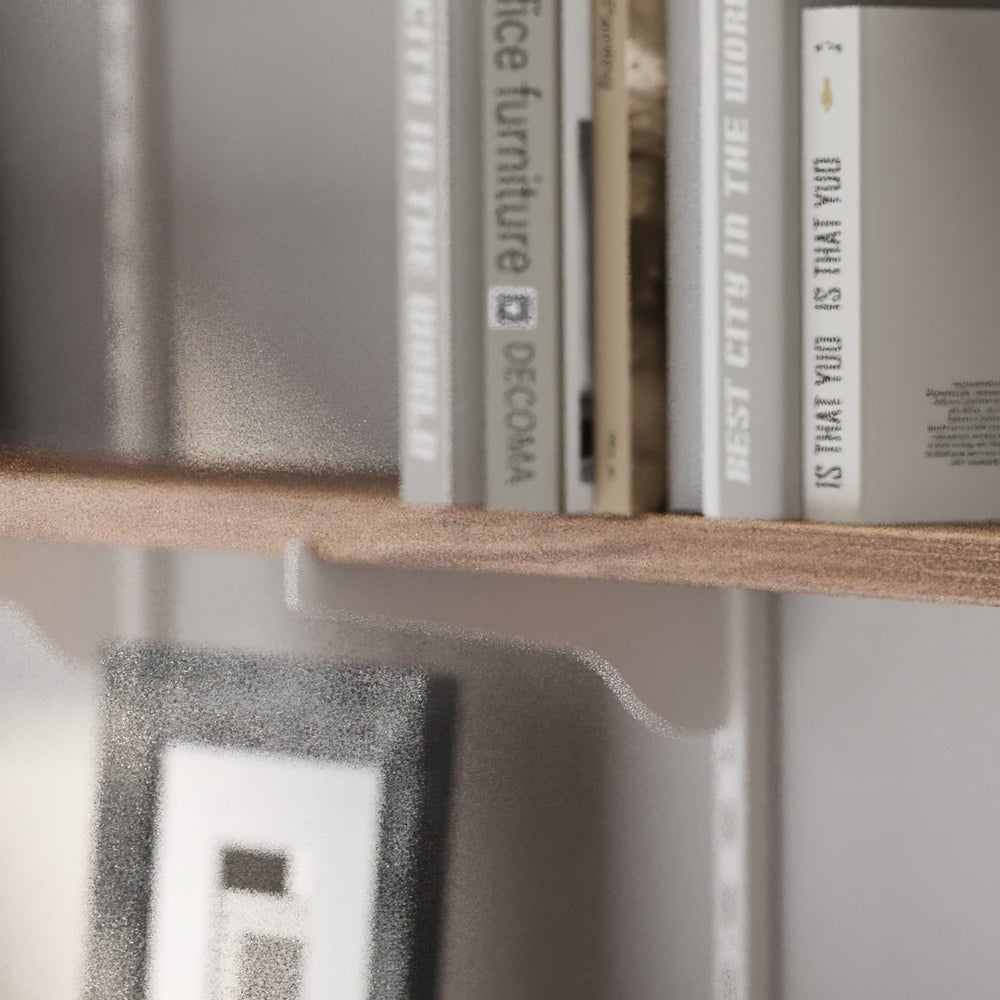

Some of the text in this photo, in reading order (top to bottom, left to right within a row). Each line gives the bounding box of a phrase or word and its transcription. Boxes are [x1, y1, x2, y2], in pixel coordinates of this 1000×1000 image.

[494, 82, 542, 273] furniture
[723, 115, 749, 198] THE
[813, 218, 841, 276] THAT
[723, 269, 749, 369] CITY
[813, 287, 841, 311] IS
[503, 341, 537, 485] DECOMA
[724, 376, 750, 486] BEST
[814, 395, 842, 454] THAT
[814, 464, 842, 489] IS
